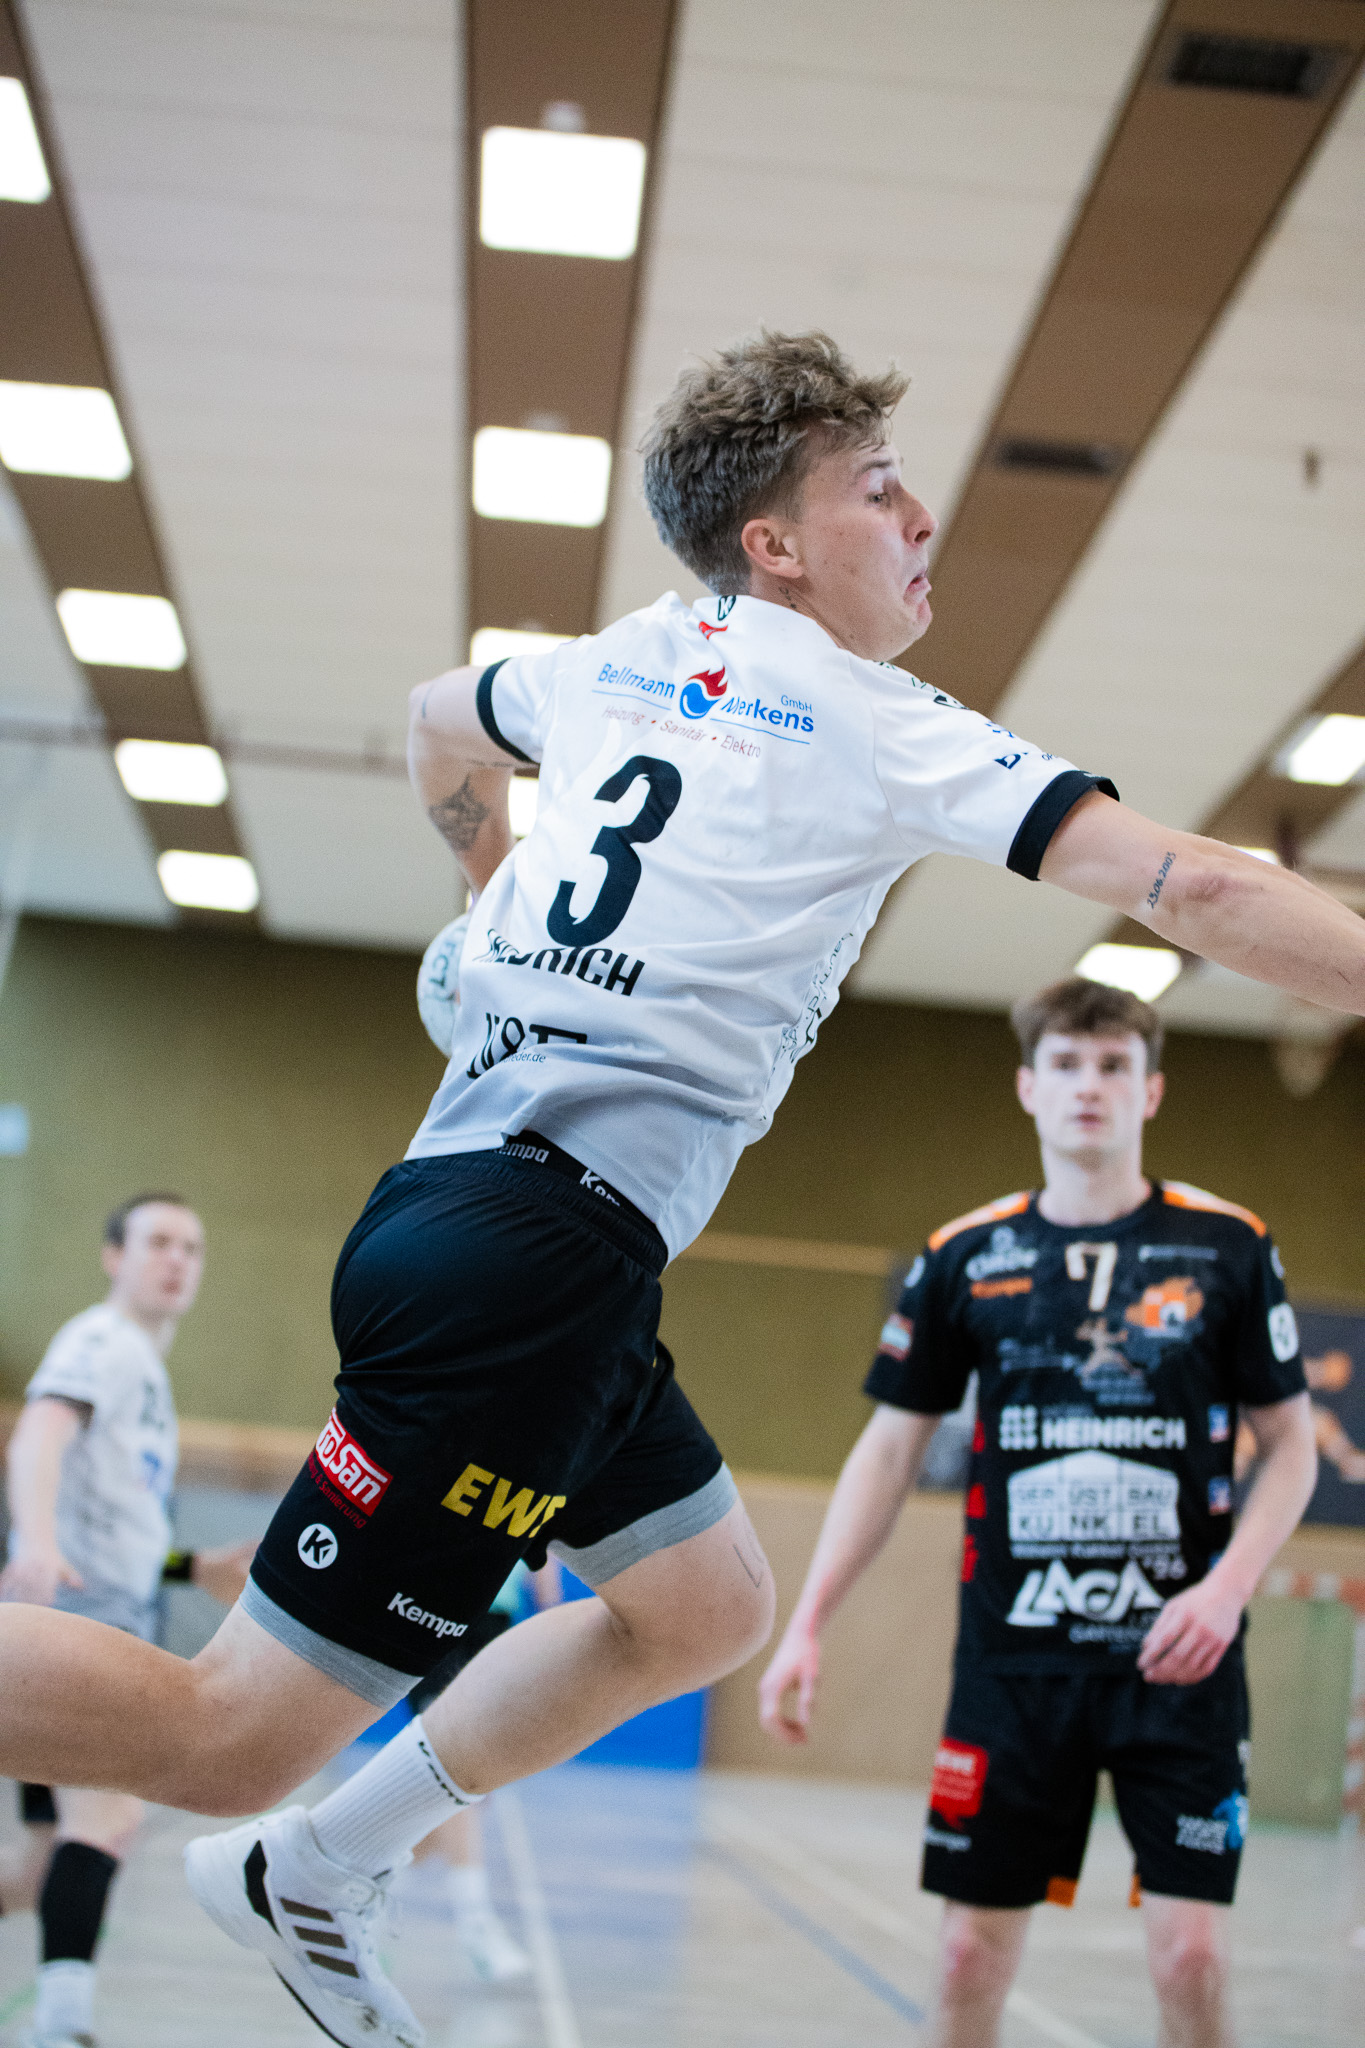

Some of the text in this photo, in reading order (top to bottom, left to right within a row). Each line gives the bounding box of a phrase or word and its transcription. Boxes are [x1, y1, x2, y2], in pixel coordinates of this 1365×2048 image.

[598, 663, 815, 732] Bellmann Merkens
[781, 695, 813, 713] GmbH
[602, 705, 762, 758] Heizung Sanitär Elektro
[546, 754, 683, 947] 3
[1065, 1241, 1118, 1312] 7
[1042, 1416, 1186, 1449] HEINRICH
[319, 1480, 368, 1529] Sanierung
[387, 1592, 469, 1638] Kempa
